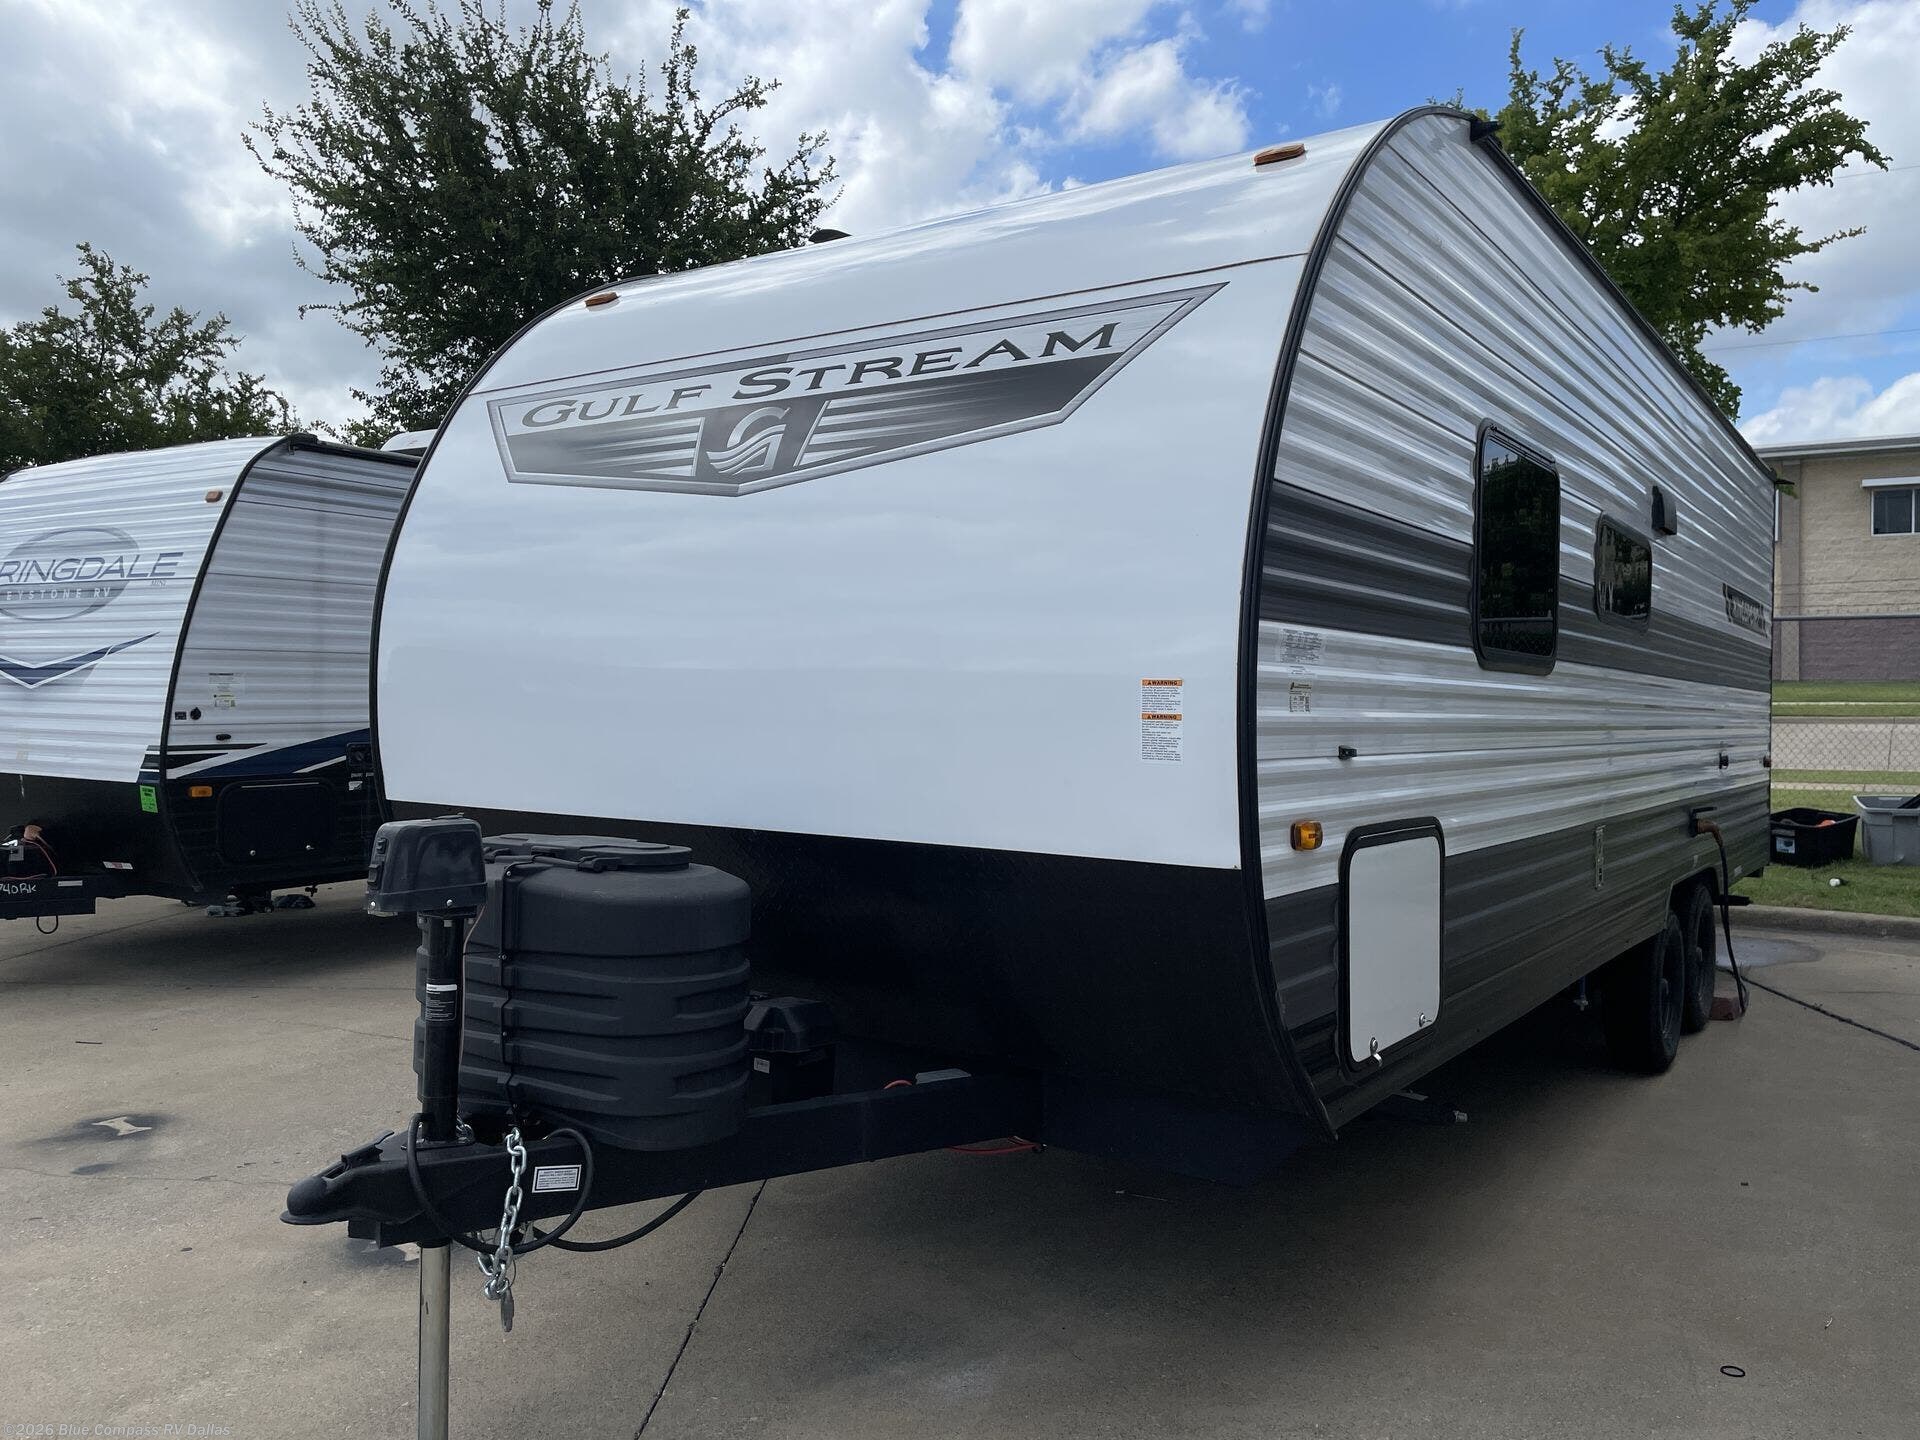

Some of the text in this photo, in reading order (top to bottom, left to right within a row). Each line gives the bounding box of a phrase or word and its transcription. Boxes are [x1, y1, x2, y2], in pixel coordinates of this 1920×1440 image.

[522, 322, 1121, 427] GULF STREAM
[94, 587, 111, 598] RV
